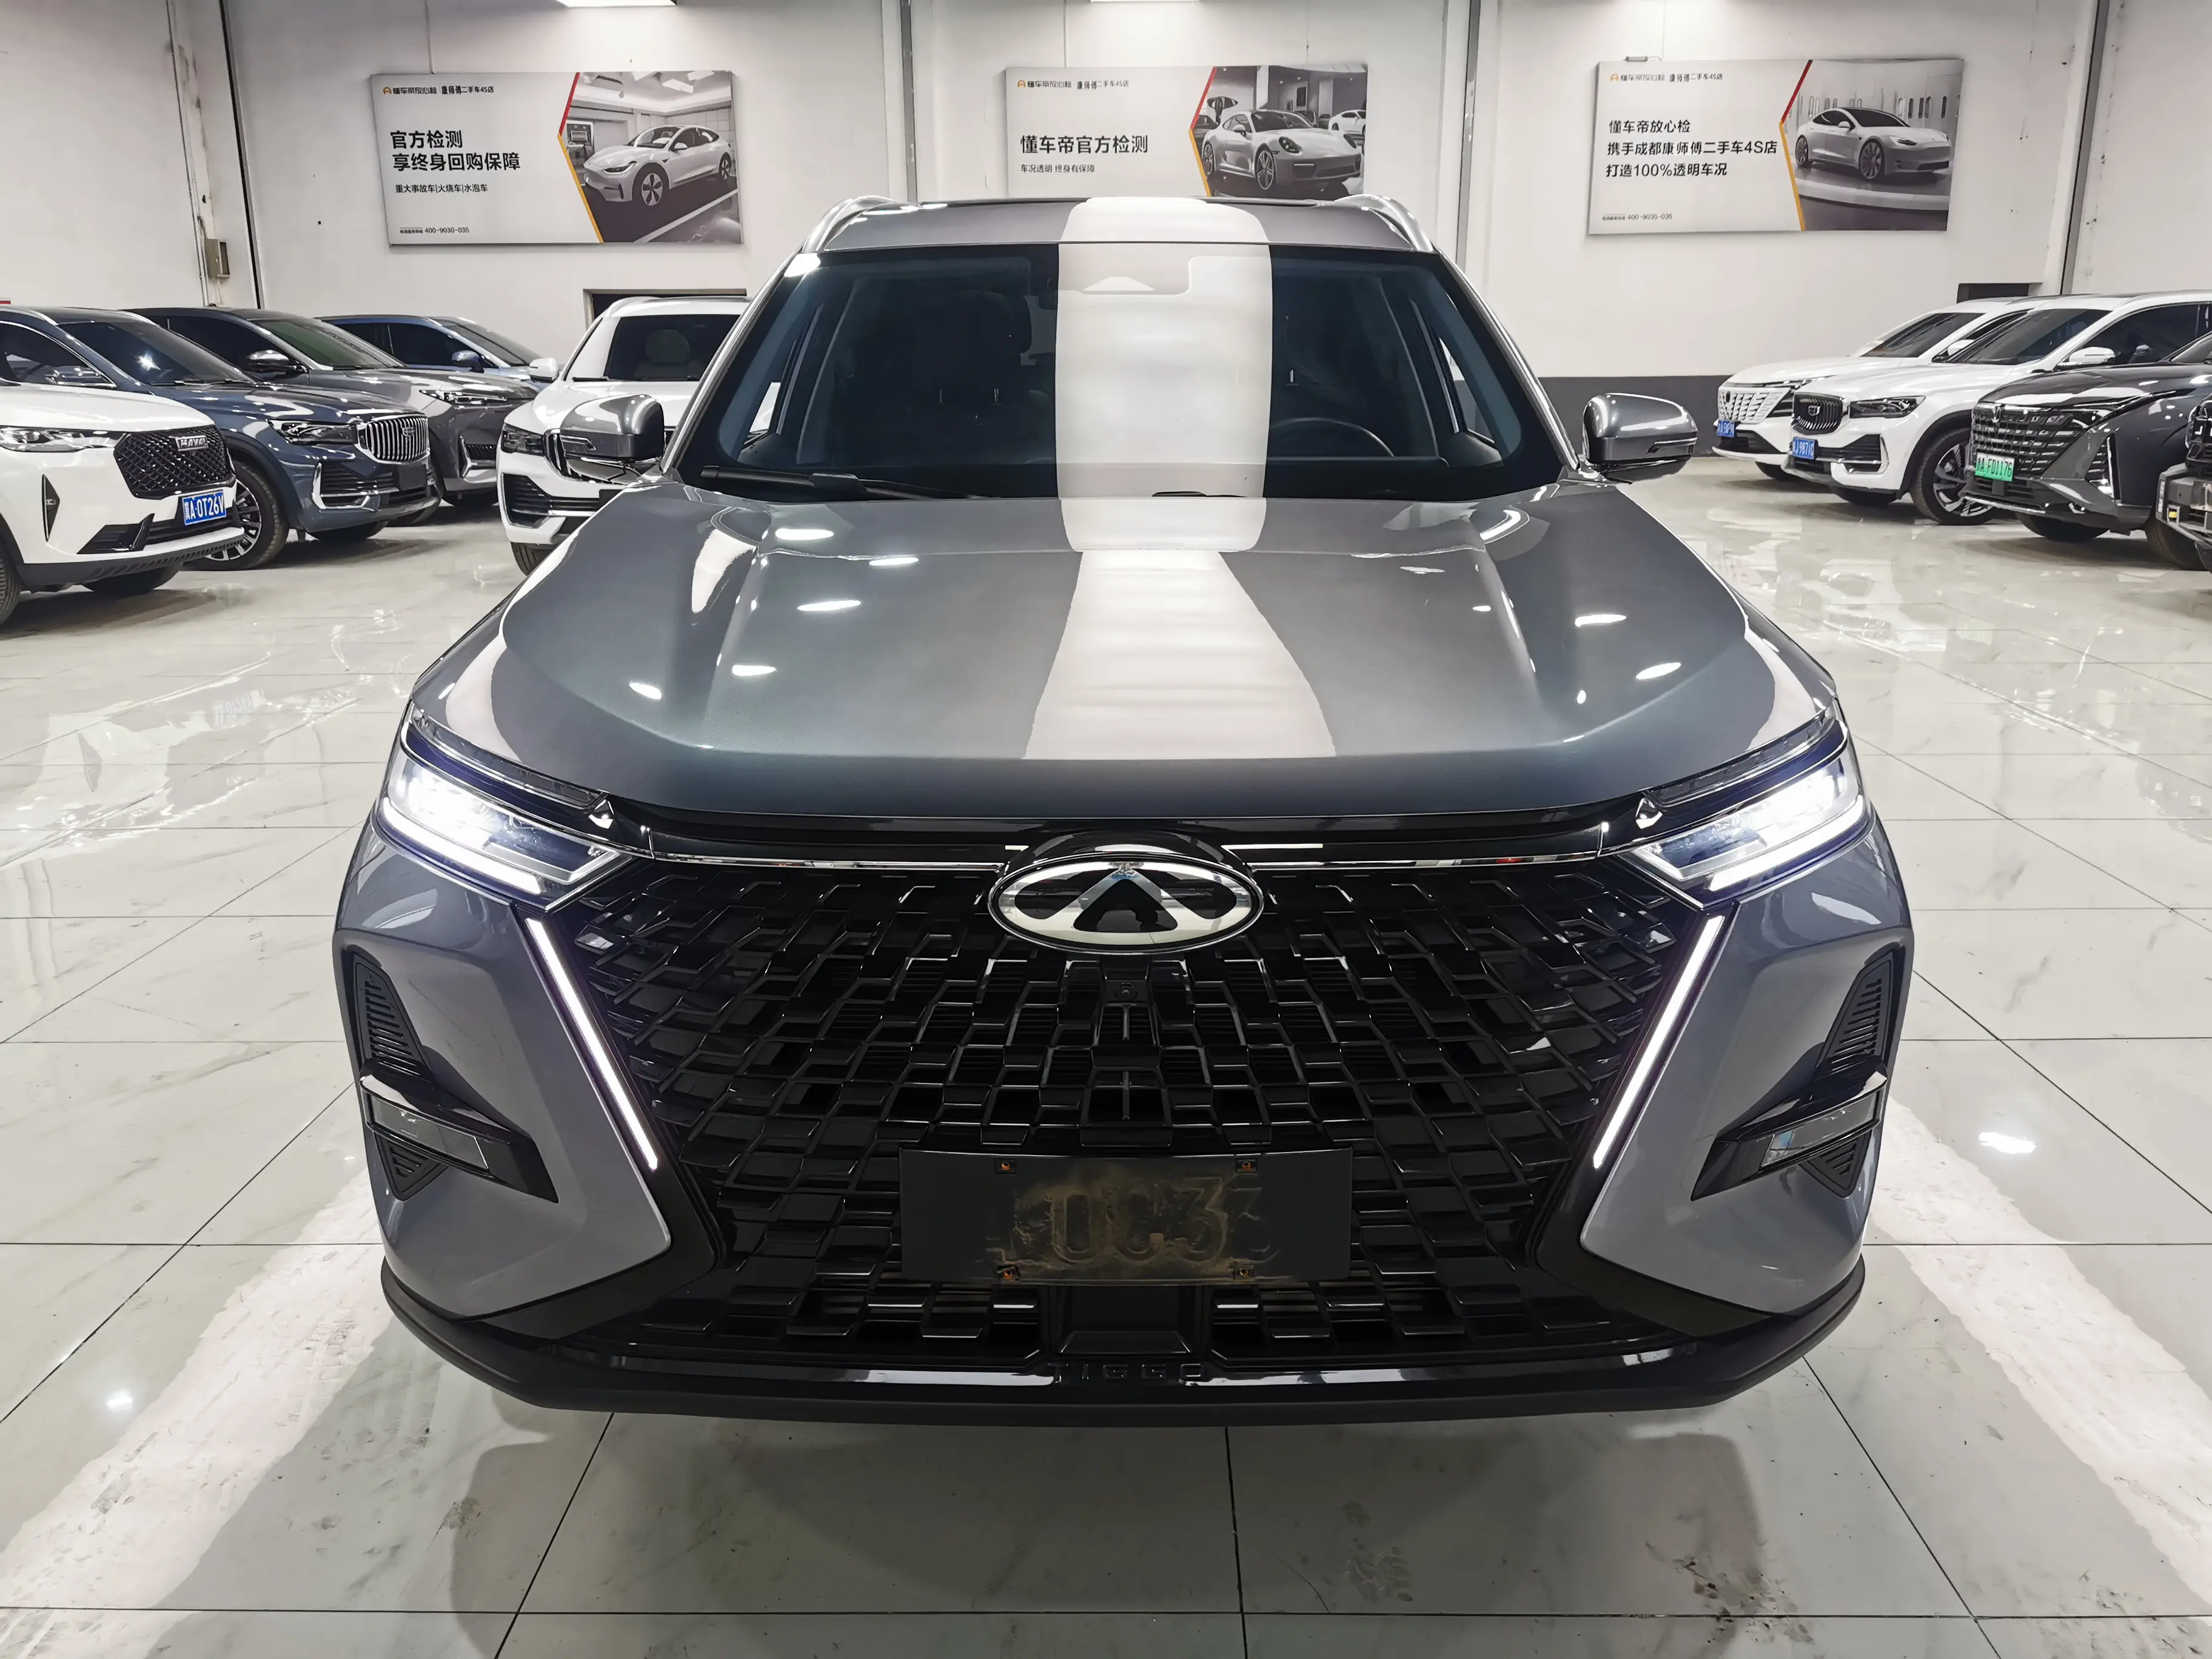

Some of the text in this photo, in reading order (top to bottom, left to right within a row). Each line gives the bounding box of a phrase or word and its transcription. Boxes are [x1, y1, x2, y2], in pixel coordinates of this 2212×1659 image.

[1609, 119, 1691, 134] 懂车帝放心检
[390, 130, 463, 149] 官方检测
[1020, 135, 1148, 154] 懂车帝官方检测
[1607, 140, 1778, 156] 携手成都康师傅二手车4S店
[392, 152, 521, 172] 享终身回购保障
[1020, 164, 1095, 173] 车况透明 终身有保障
[1606, 162, 1728, 178] 打造100%透明车况
